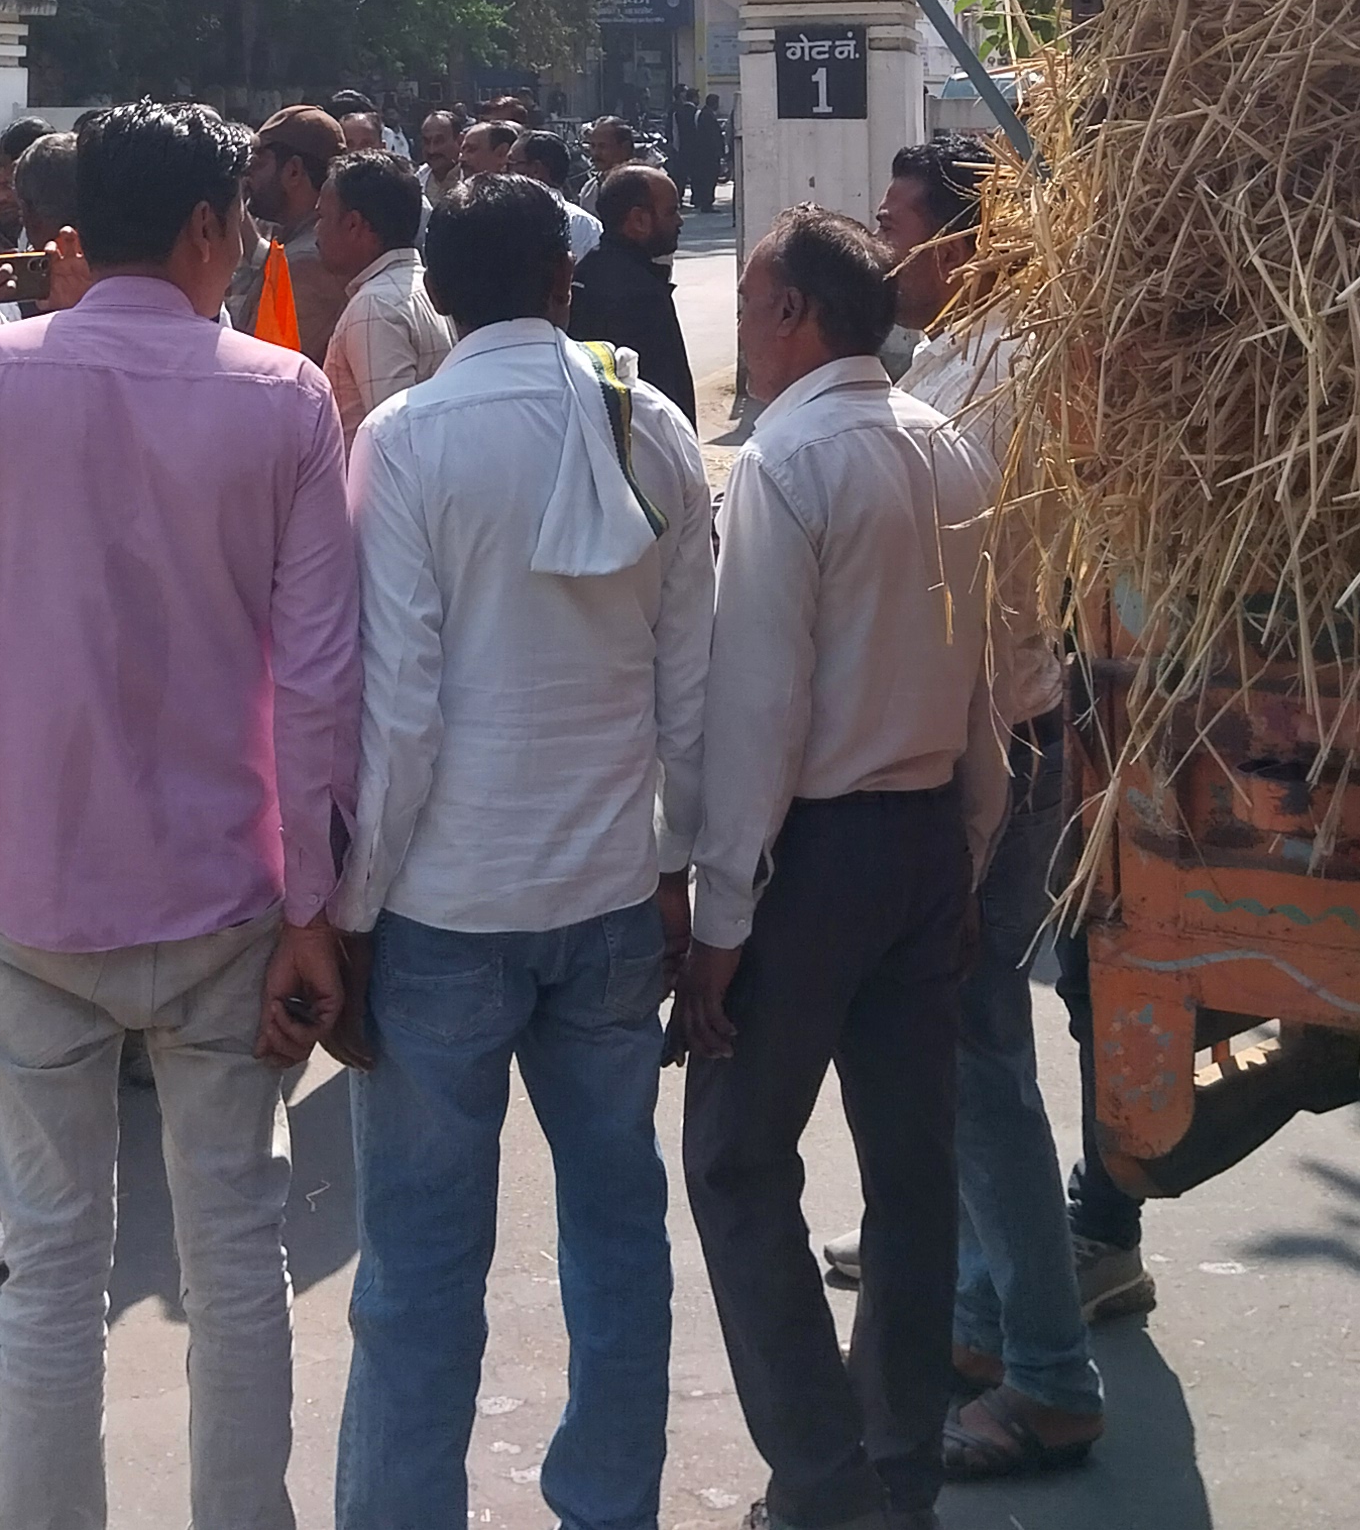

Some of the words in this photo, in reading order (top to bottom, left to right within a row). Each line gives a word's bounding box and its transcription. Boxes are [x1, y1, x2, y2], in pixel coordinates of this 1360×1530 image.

[786, 33, 832, 61] गेट
[834, 31, 860, 60] नं.
[811, 67, 833, 113] 1
